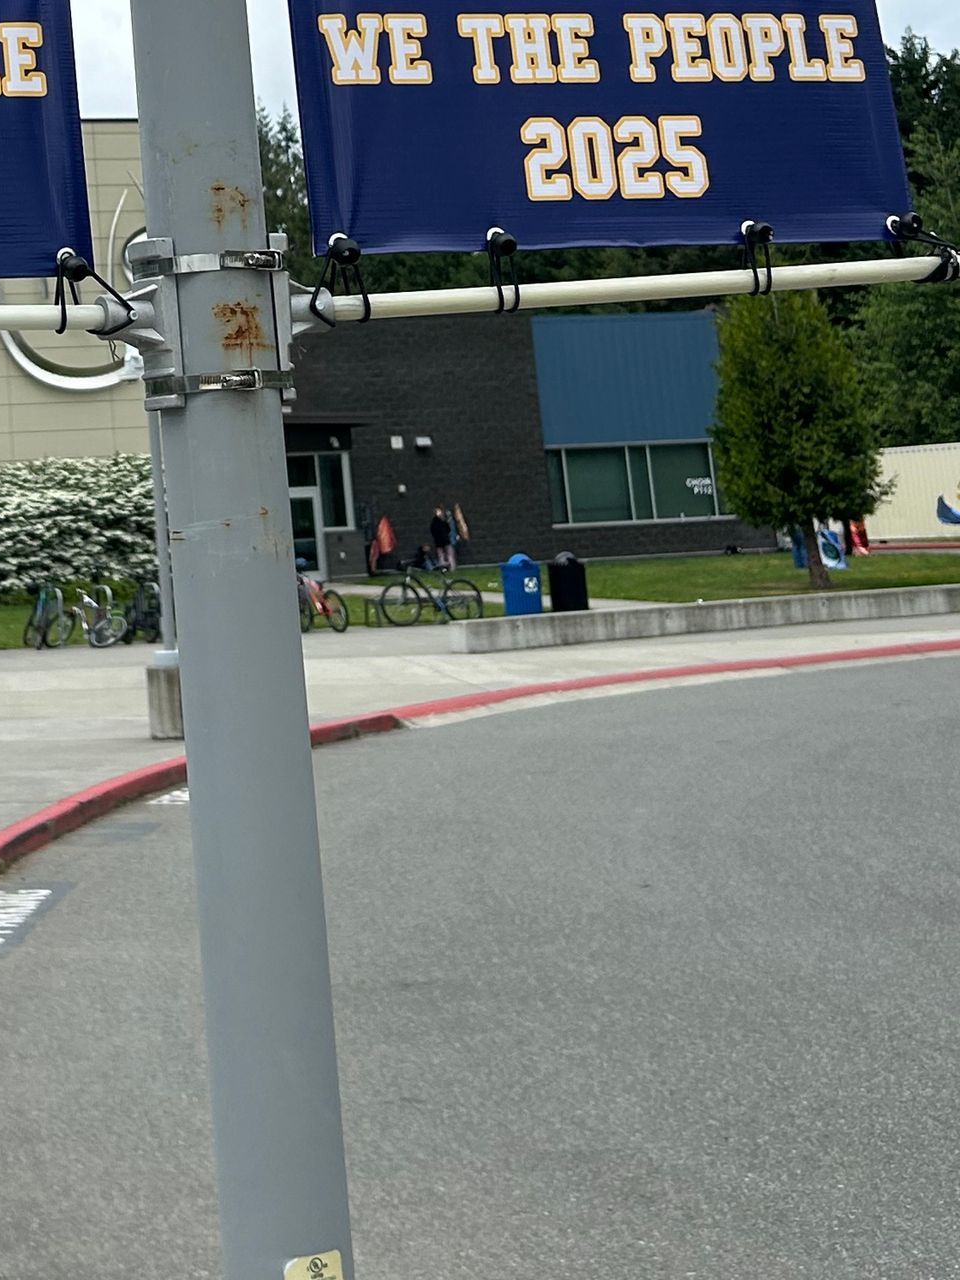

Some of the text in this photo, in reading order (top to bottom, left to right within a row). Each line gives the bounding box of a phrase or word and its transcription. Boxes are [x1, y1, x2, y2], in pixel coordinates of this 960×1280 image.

[317, 12, 866, 86] WE THE PEOPLE
[519, 115, 710, 202] 2025
